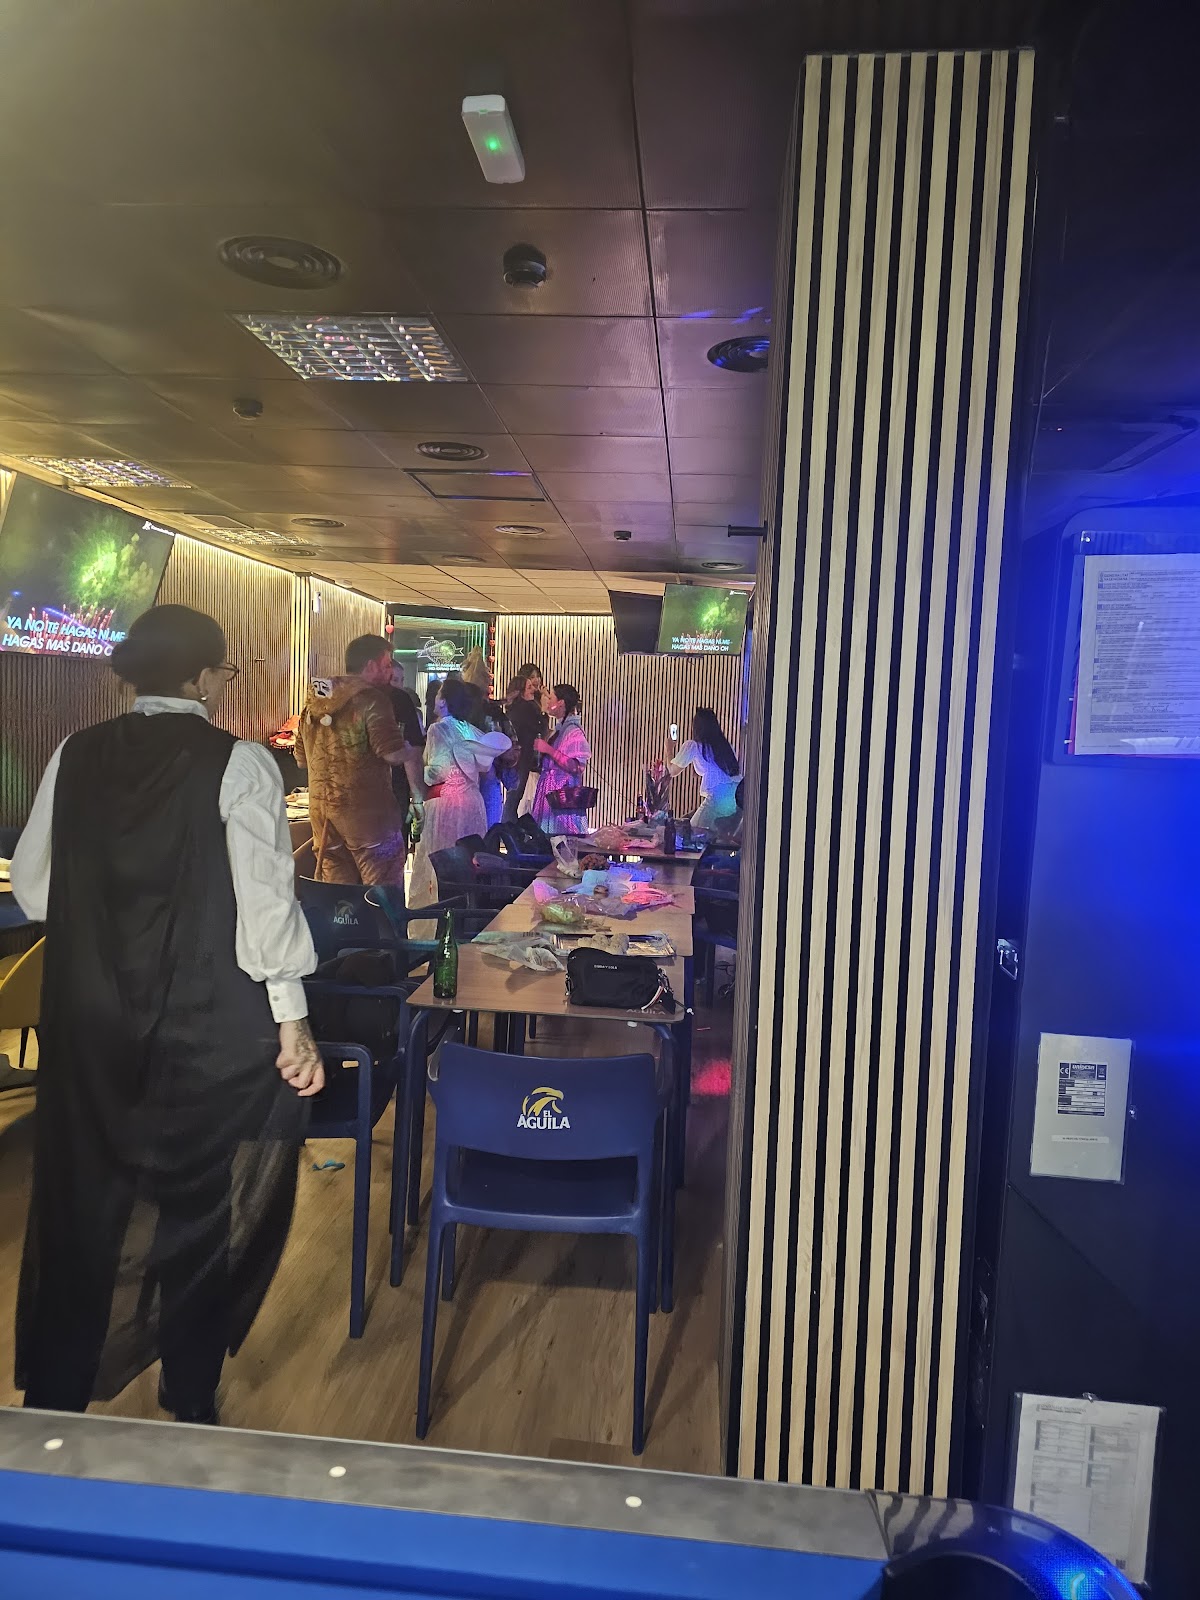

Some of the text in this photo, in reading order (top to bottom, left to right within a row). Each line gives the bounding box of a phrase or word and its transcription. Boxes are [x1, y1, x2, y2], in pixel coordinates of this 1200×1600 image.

[7, 615, 22, 629] YA
[24, 618, 45, 632] NO
[47, 621, 59, 635] TE
[60, 624, 97, 639] HAGAS
[2, 633, 45, 650] HAGAS
[45, 639, 70, 652] MAS
[71, 639, 102, 655] DAÑO
[516, 1113, 571, 1130] ÁGUILA
[543, 1109, 552, 1118] EL
